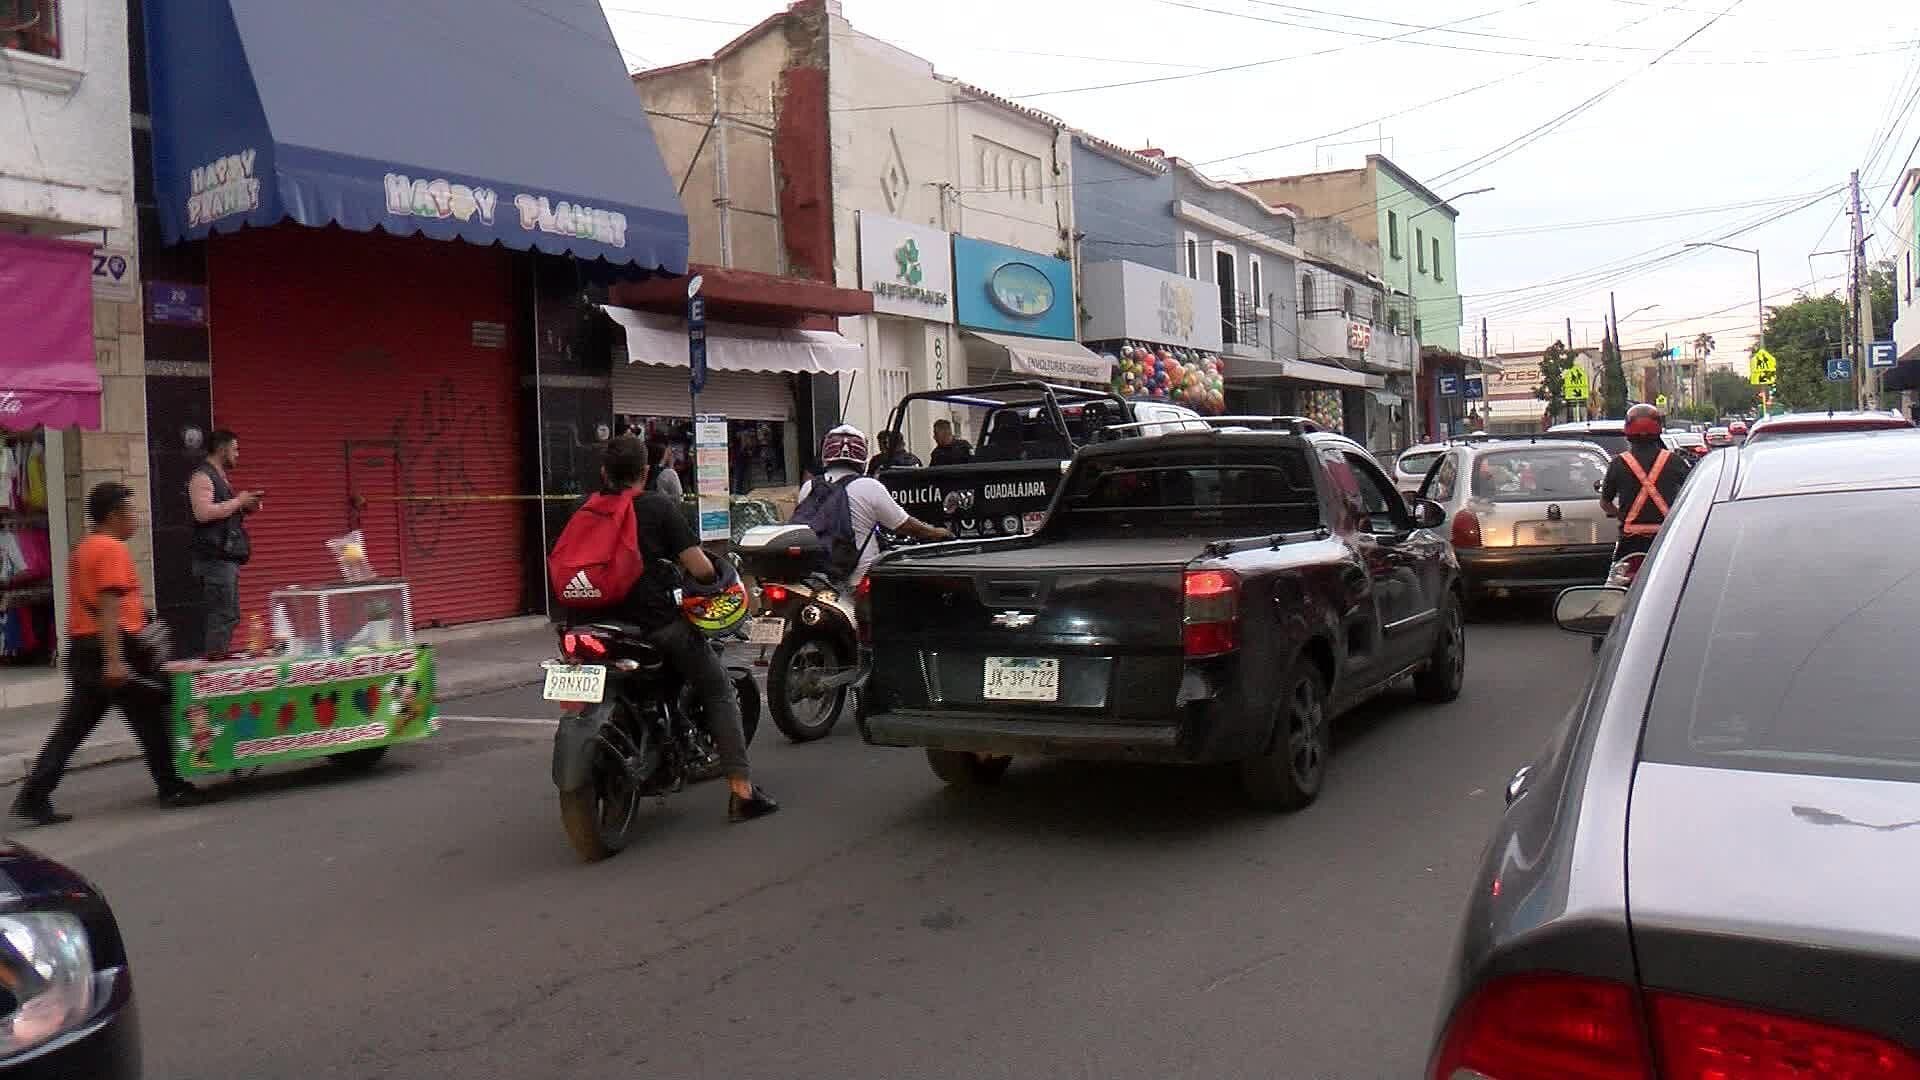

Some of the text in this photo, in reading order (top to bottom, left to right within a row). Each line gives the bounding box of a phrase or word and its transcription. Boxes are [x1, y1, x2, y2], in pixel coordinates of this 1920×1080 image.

[191, 148, 256, 194] HAPPY
[188, 179, 259, 228] PLANET
[385, 173, 627, 248] HAPPY PLANET
[1873, 346, 1893, 365] E
[1441, 377, 1457, 394] E
[891, 481, 1046, 505] POLICÍA GUADALAJARA
[563, 588, 601, 598] adidas
[193, 650, 418, 698] RICAS JICALETAS
[234, 721, 389, 759] PREPARADAS
